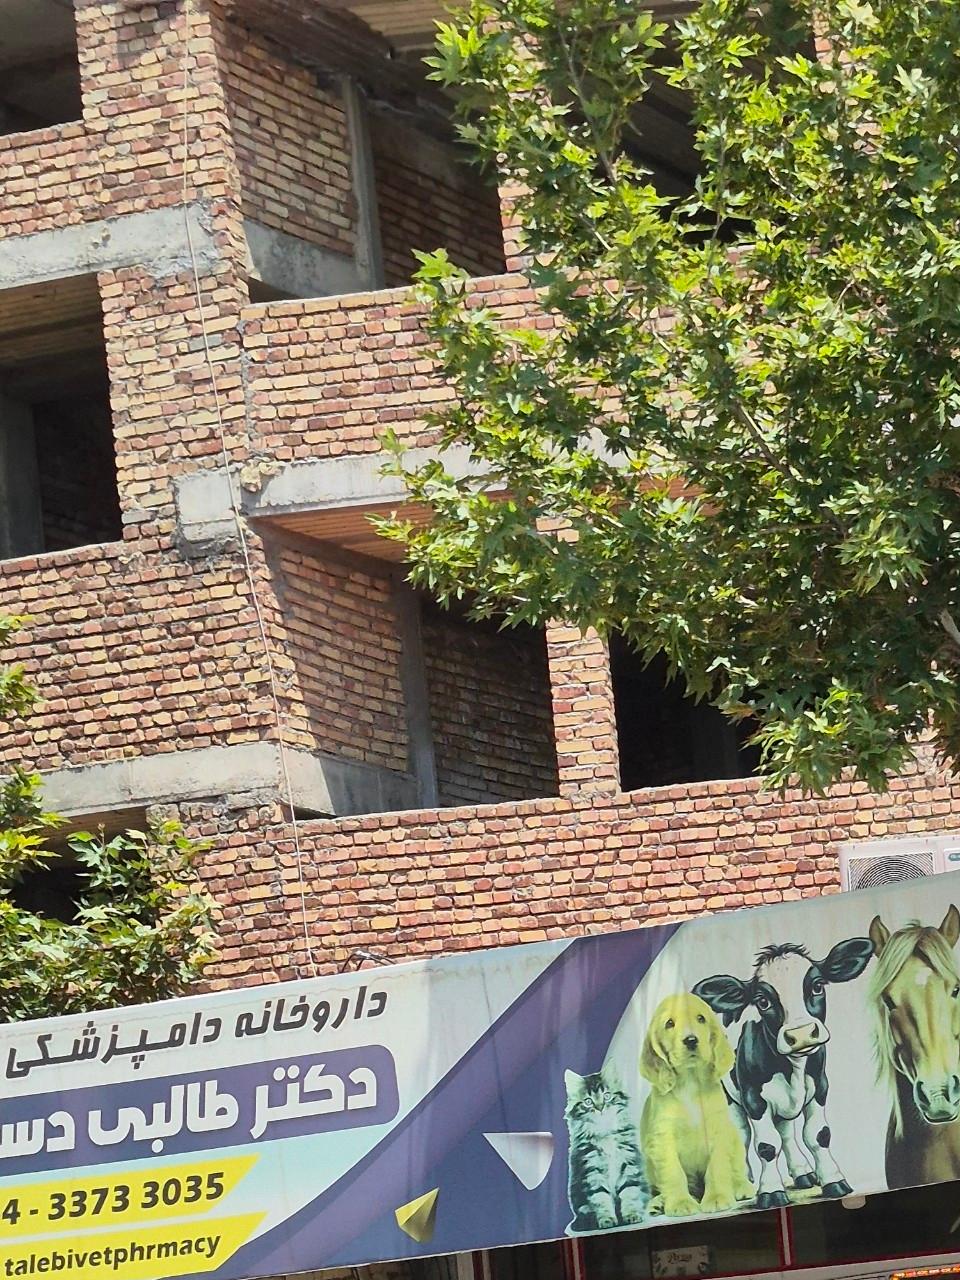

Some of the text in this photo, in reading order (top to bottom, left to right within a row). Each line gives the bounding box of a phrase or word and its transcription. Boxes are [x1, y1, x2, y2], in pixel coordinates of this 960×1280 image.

[5, 985, 389, 1080] داروخانه دامپزشکی
[0, 1063, 378, 1159] دکتر طالبی دس
[48, 1184, 131, 1221] 3373
[140, 1172, 225, 1209] 3035
[4, 1235, 221, 1277] talebivetphrmacy
